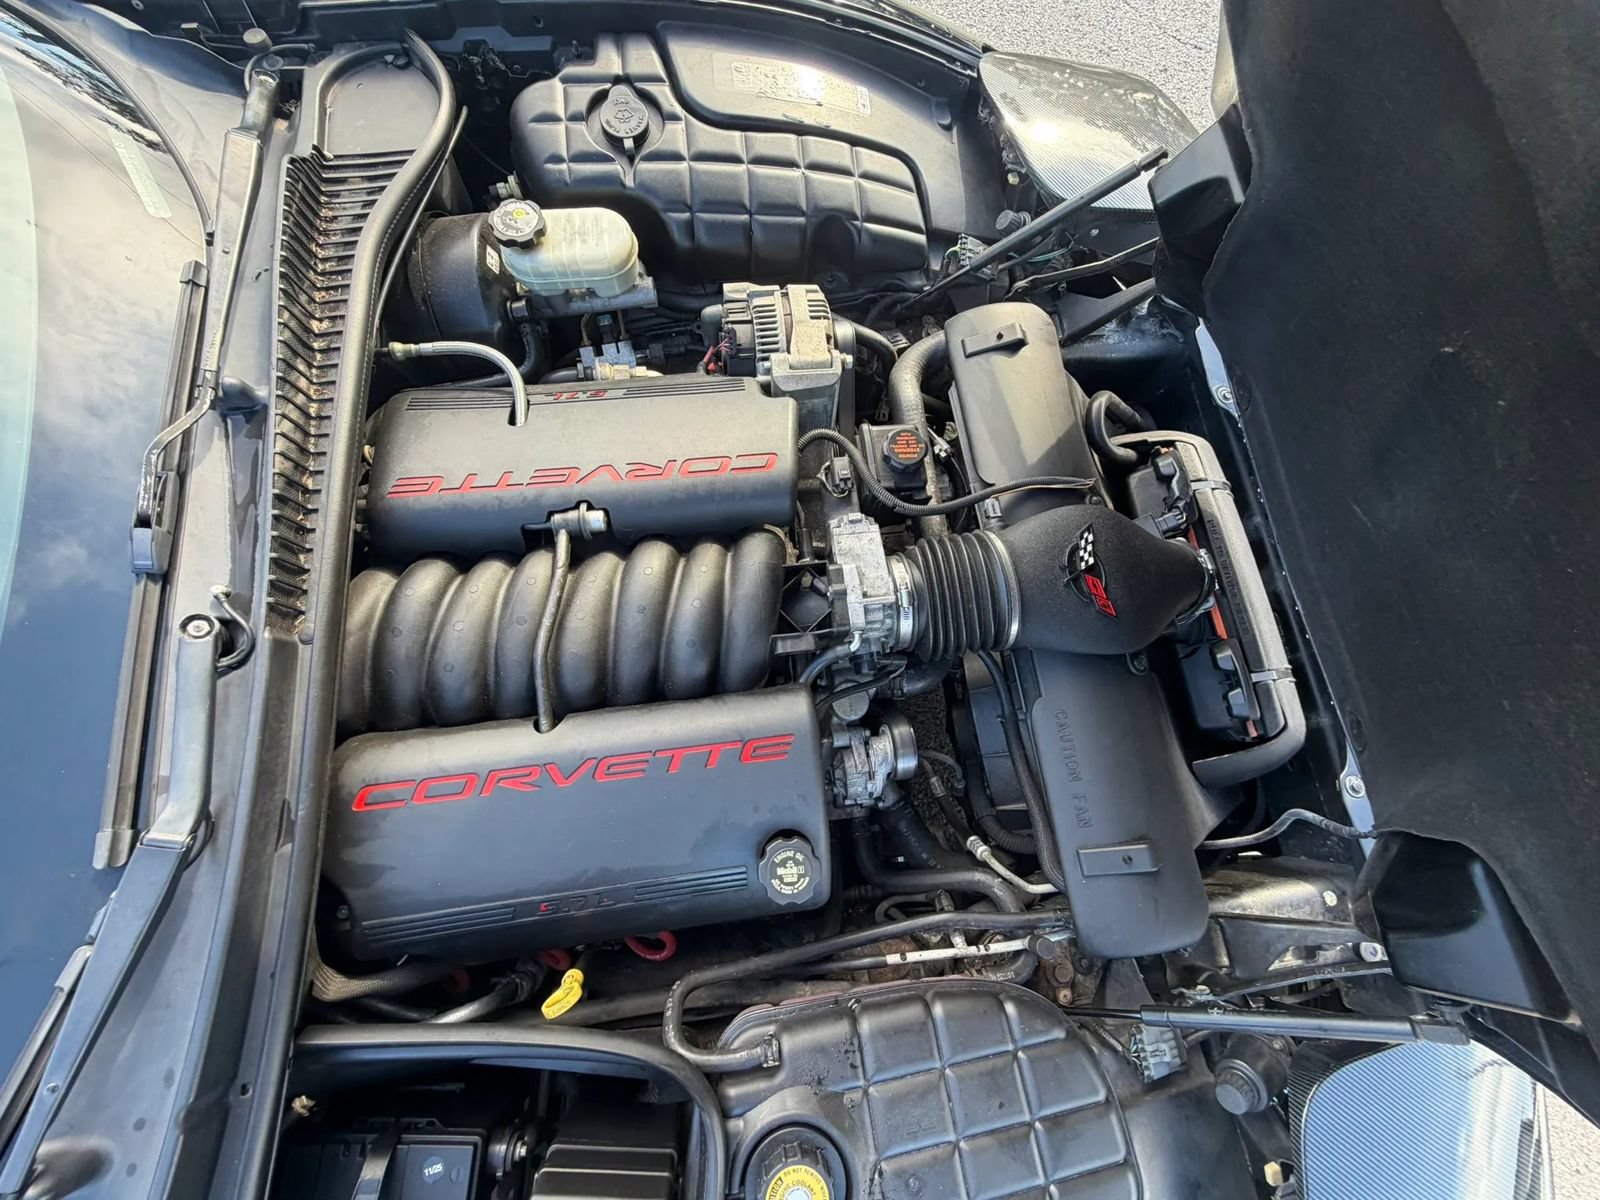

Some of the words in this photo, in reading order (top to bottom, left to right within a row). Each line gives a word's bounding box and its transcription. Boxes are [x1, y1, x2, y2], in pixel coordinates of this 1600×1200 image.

[386, 452, 779, 497] CORVETTE
[1207, 518, 1221, 542] PULL
[1216, 544, 1226, 558] TO
[1220, 559, 1239, 600] SERVICE
[351, 733, 796, 812] CORVETTE
[1054, 709, 1083, 782] CAUTION
[1072, 793, 1095, 829] FAN
[774, 850, 795, 863] ENGINE
[795, 852, 805, 862] OIL
[537, 892, 616, 915] 5.7L
[423, 1162, 443, 1177] 11/25
[791, 1179, 817, 1196] COOLANT
